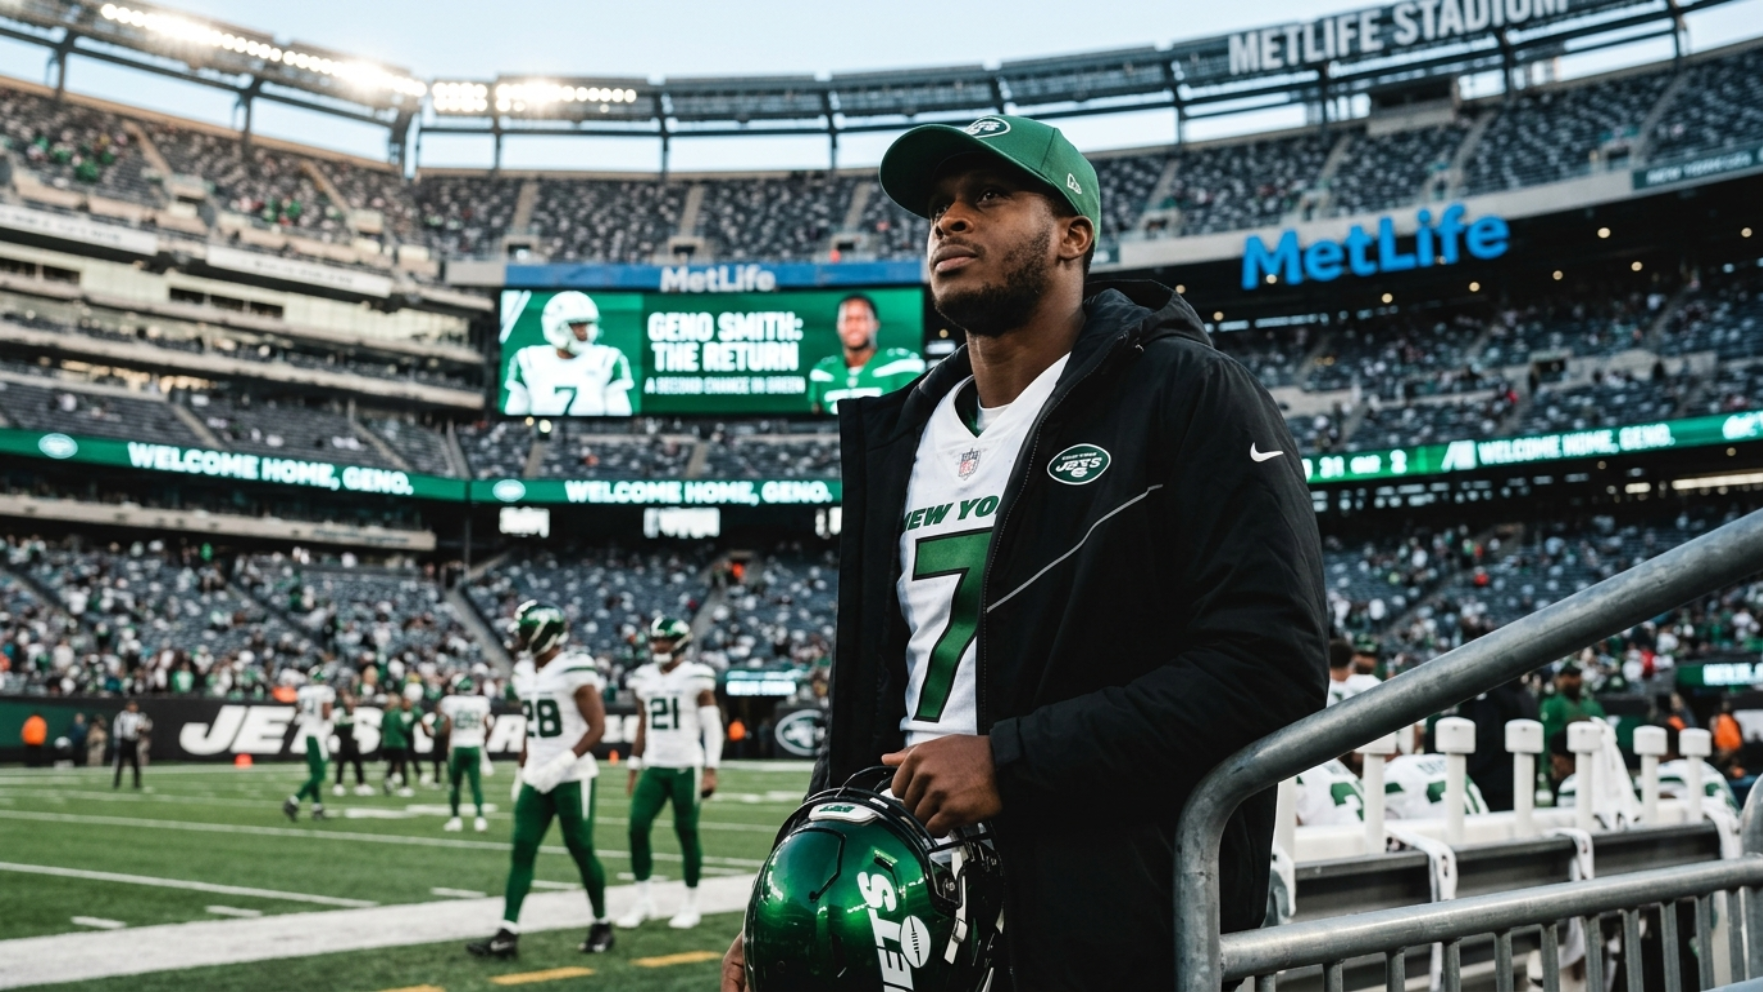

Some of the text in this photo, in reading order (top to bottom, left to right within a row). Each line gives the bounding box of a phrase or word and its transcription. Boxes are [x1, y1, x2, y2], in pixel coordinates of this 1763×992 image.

[1228, 9, 1384, 76] METLIFE
[1242, 204, 1510, 290] MetLife
[660, 264, 776, 293] MetLife
[647, 311, 804, 342] GENO SMITH:
[651, 341, 799, 372] THE RETURN
[1477, 434, 1560, 465] WELCOME
[1562, 429, 1620, 457] HOME,
[127, 441, 414, 495] WELCOME HOME, GENO.
[564, 479, 833, 507] WELCOME HOME, GENO.
[957, 495, 1000, 521] YO
[912, 526, 994, 723] 7
[179, 705, 385, 756] JES
[522, 699, 563, 738] 28
[650, 697, 679, 730] 21
[857, 871, 916, 992] ETS
